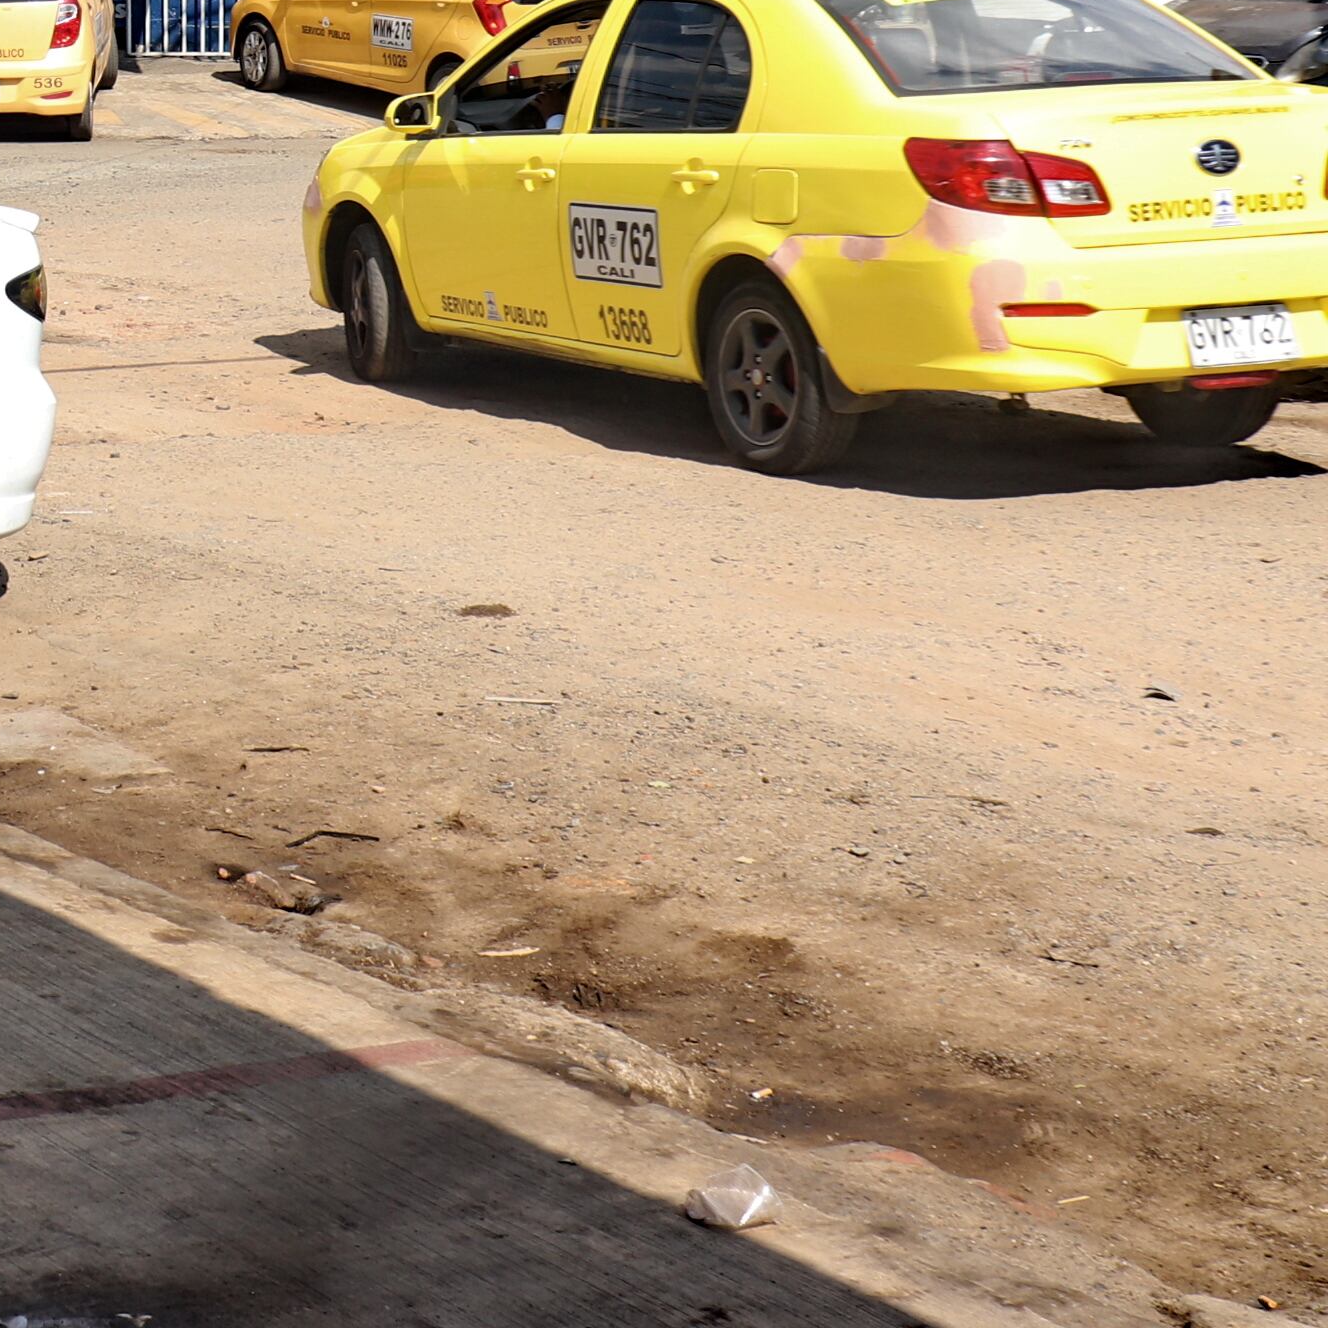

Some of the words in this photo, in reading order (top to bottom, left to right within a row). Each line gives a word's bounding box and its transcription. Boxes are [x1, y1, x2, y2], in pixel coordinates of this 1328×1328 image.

[301, 25, 325, 36] SERVICIO
[328, 29, 351, 41] PUBLICO
[547, 35, 582, 46] SERVICIO
[33, 78, 63, 89] 536
[1129, 198, 1212, 222] SERVICIO
[1236, 191, 1308, 214] PUBLICO
[597, 265, 635, 279] CALI
[441, 294, 485, 318] SERVICIO
[503, 304, 548, 328] PUBLICO
[598, 304, 653, 345] 13668
